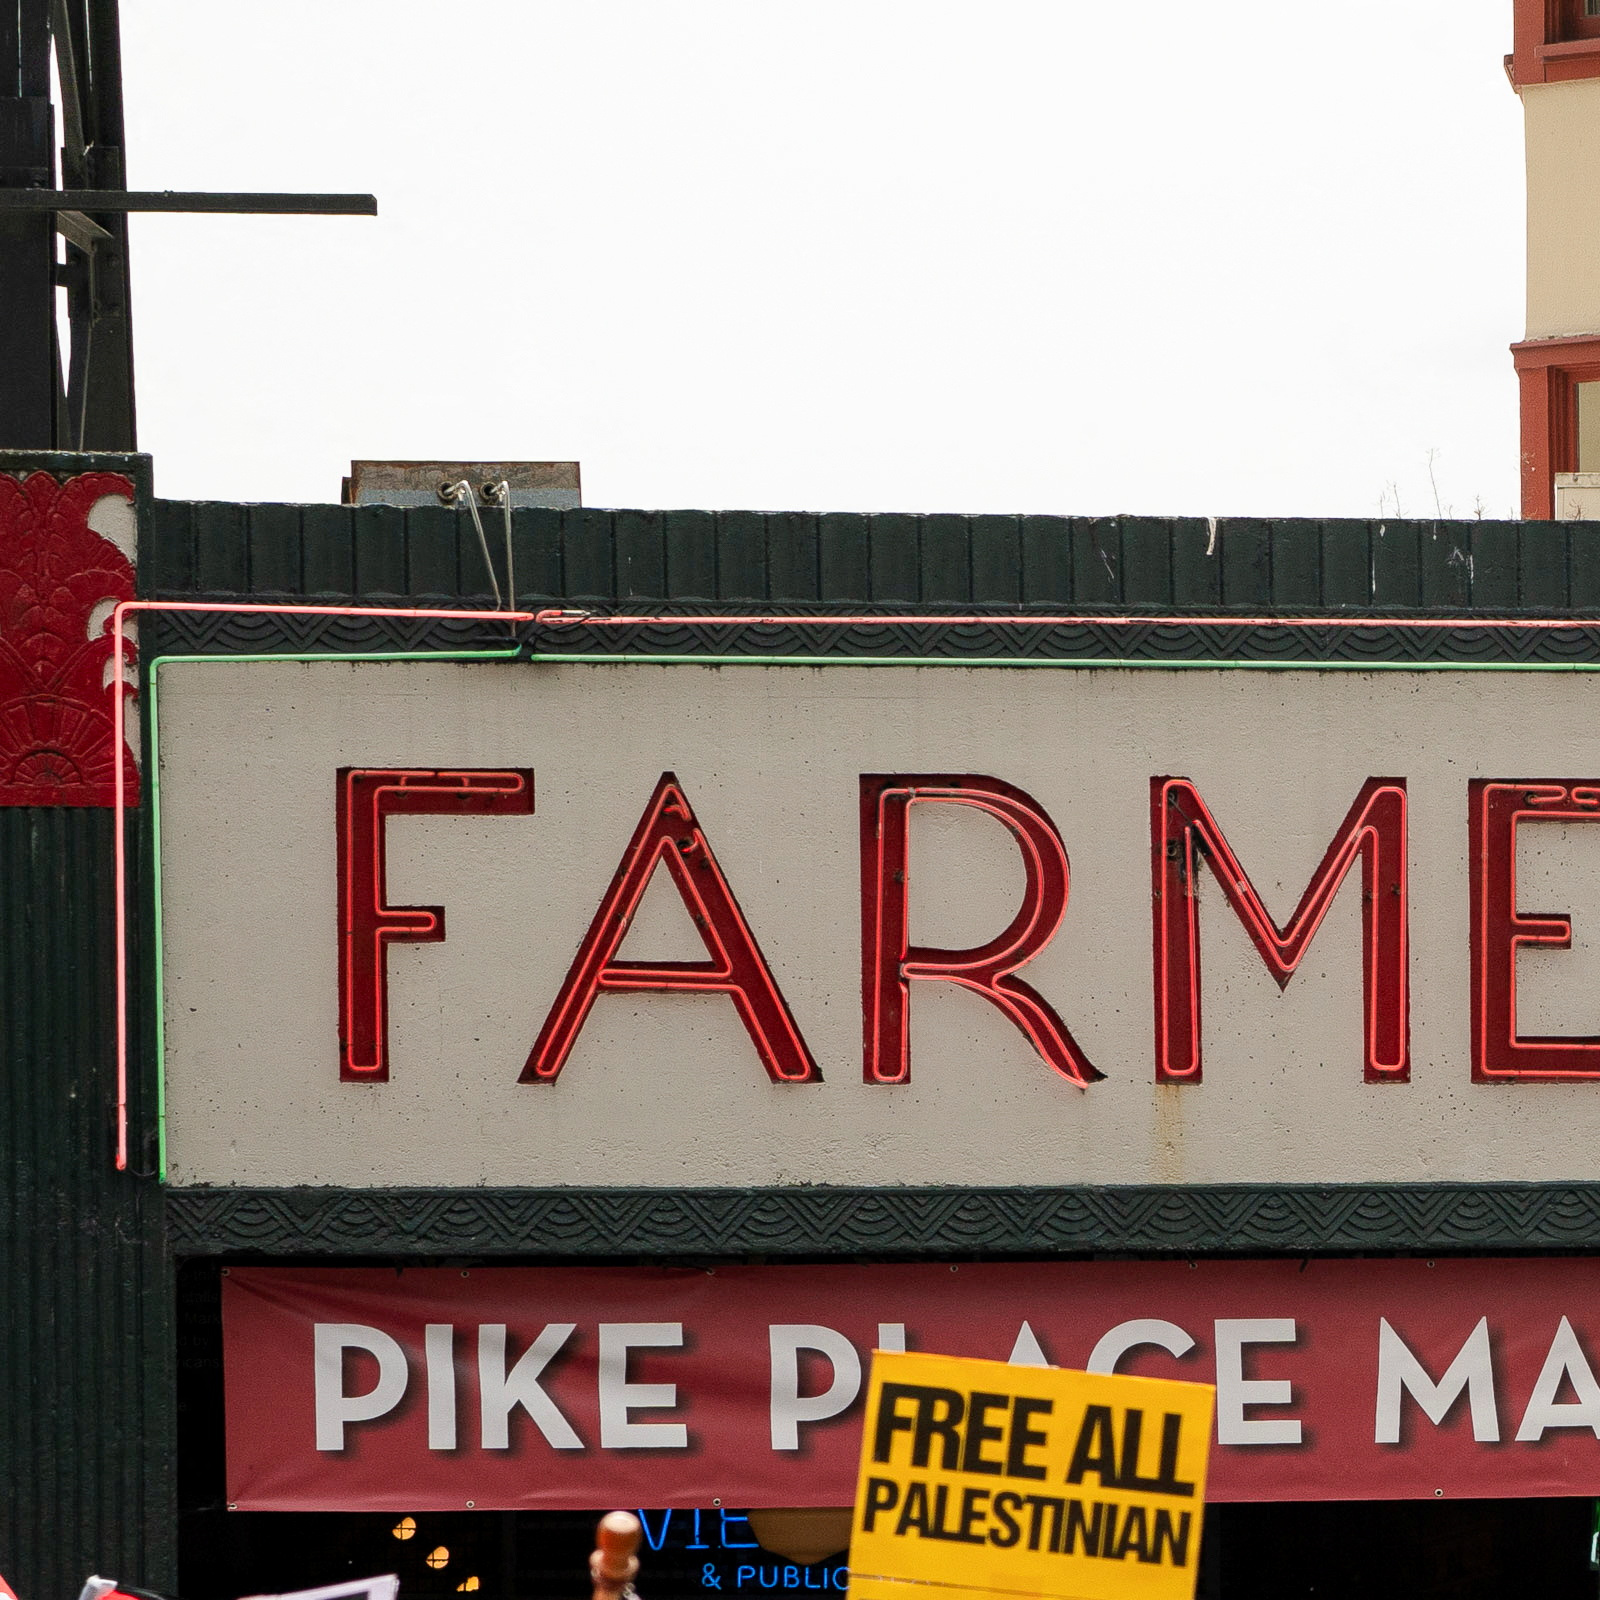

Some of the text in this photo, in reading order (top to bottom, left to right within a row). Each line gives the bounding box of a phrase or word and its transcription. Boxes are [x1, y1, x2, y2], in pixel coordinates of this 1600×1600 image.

[313, 1322, 689, 1452] PIKE
[872, 1381, 1196, 1497] FREE ALL
[861, 1476, 1193, 1568] PALESTINIAN
[701, 1562, 850, 1591] & PUBLIC
